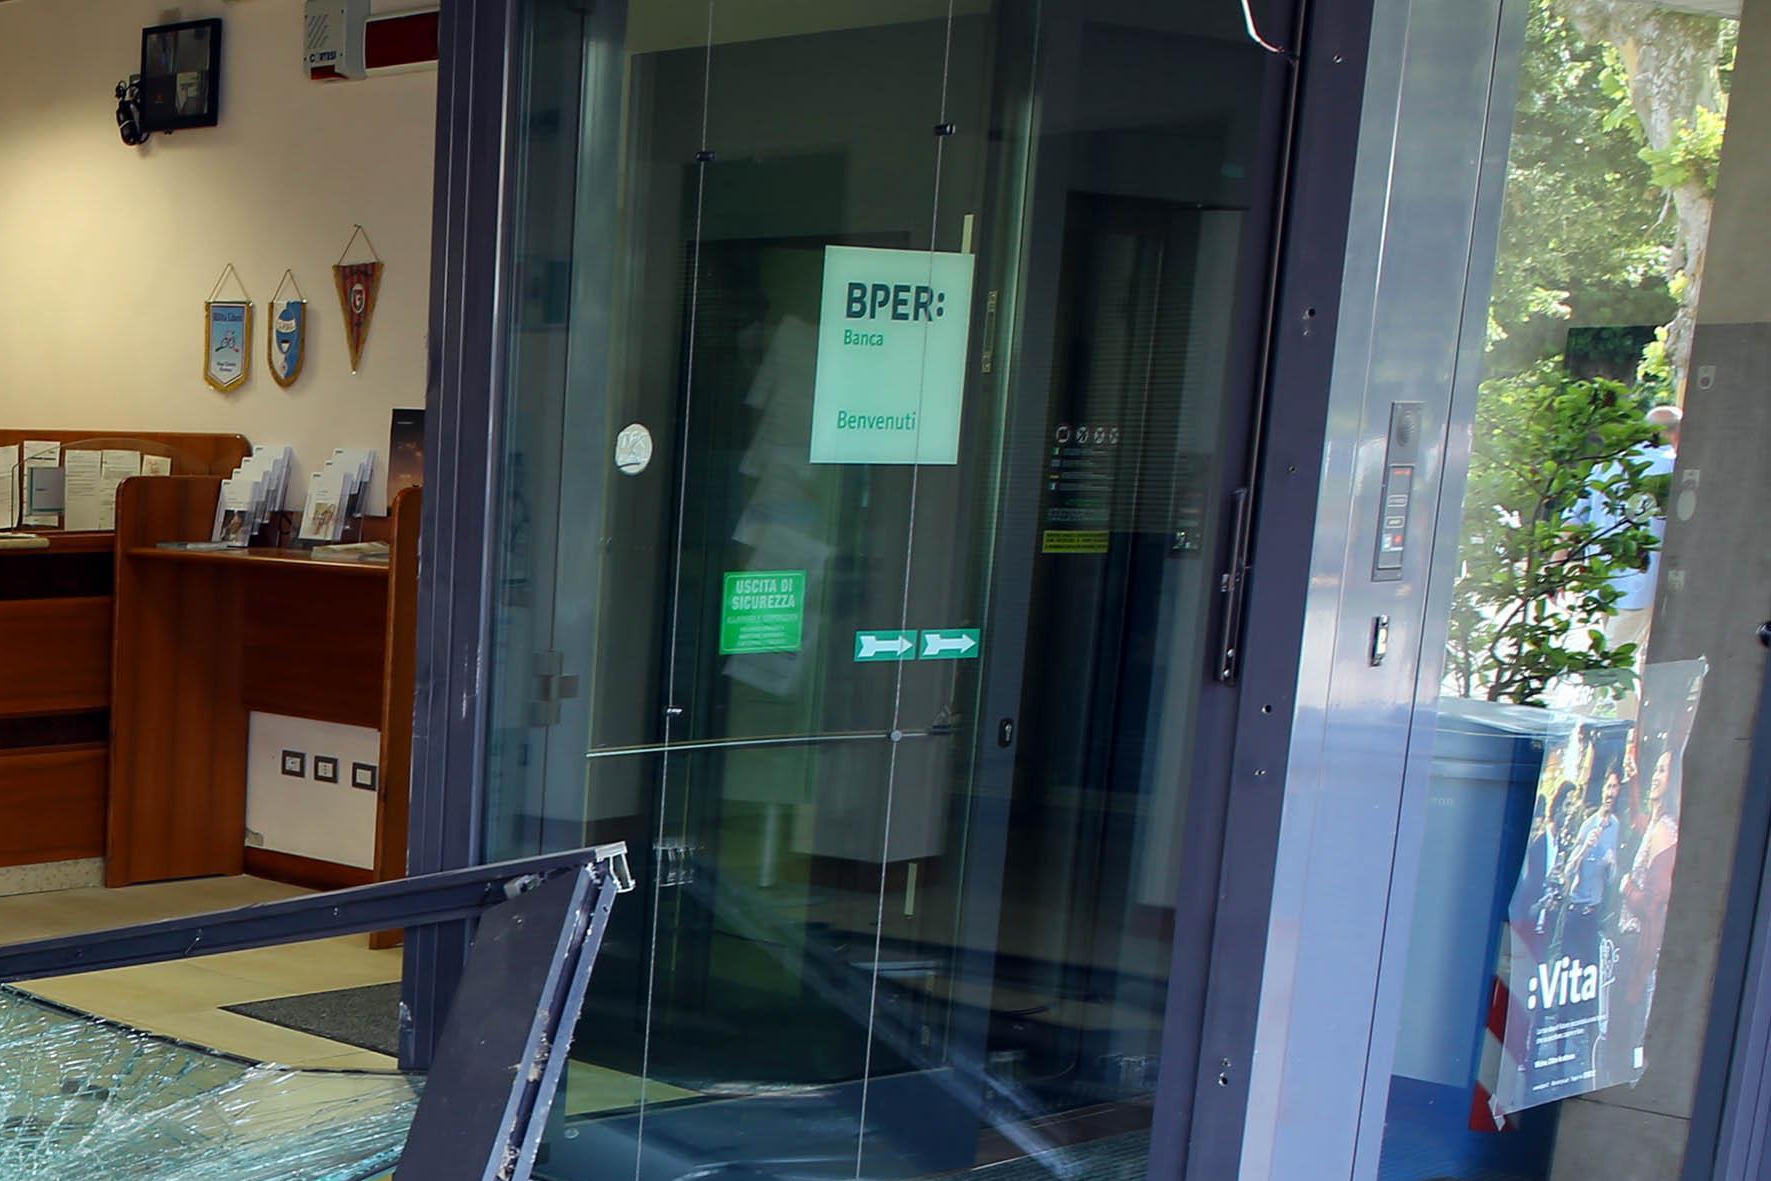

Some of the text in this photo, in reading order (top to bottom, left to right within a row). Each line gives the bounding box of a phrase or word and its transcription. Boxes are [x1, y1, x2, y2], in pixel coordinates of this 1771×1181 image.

[846, 282, 946, 322] BPER:
[843, 329, 884, 346] Banca
[836, 410, 917, 431] Benvenuti
[736, 577, 793, 594] USCITA DI
[731, 594, 795, 610] SICUREZZA
